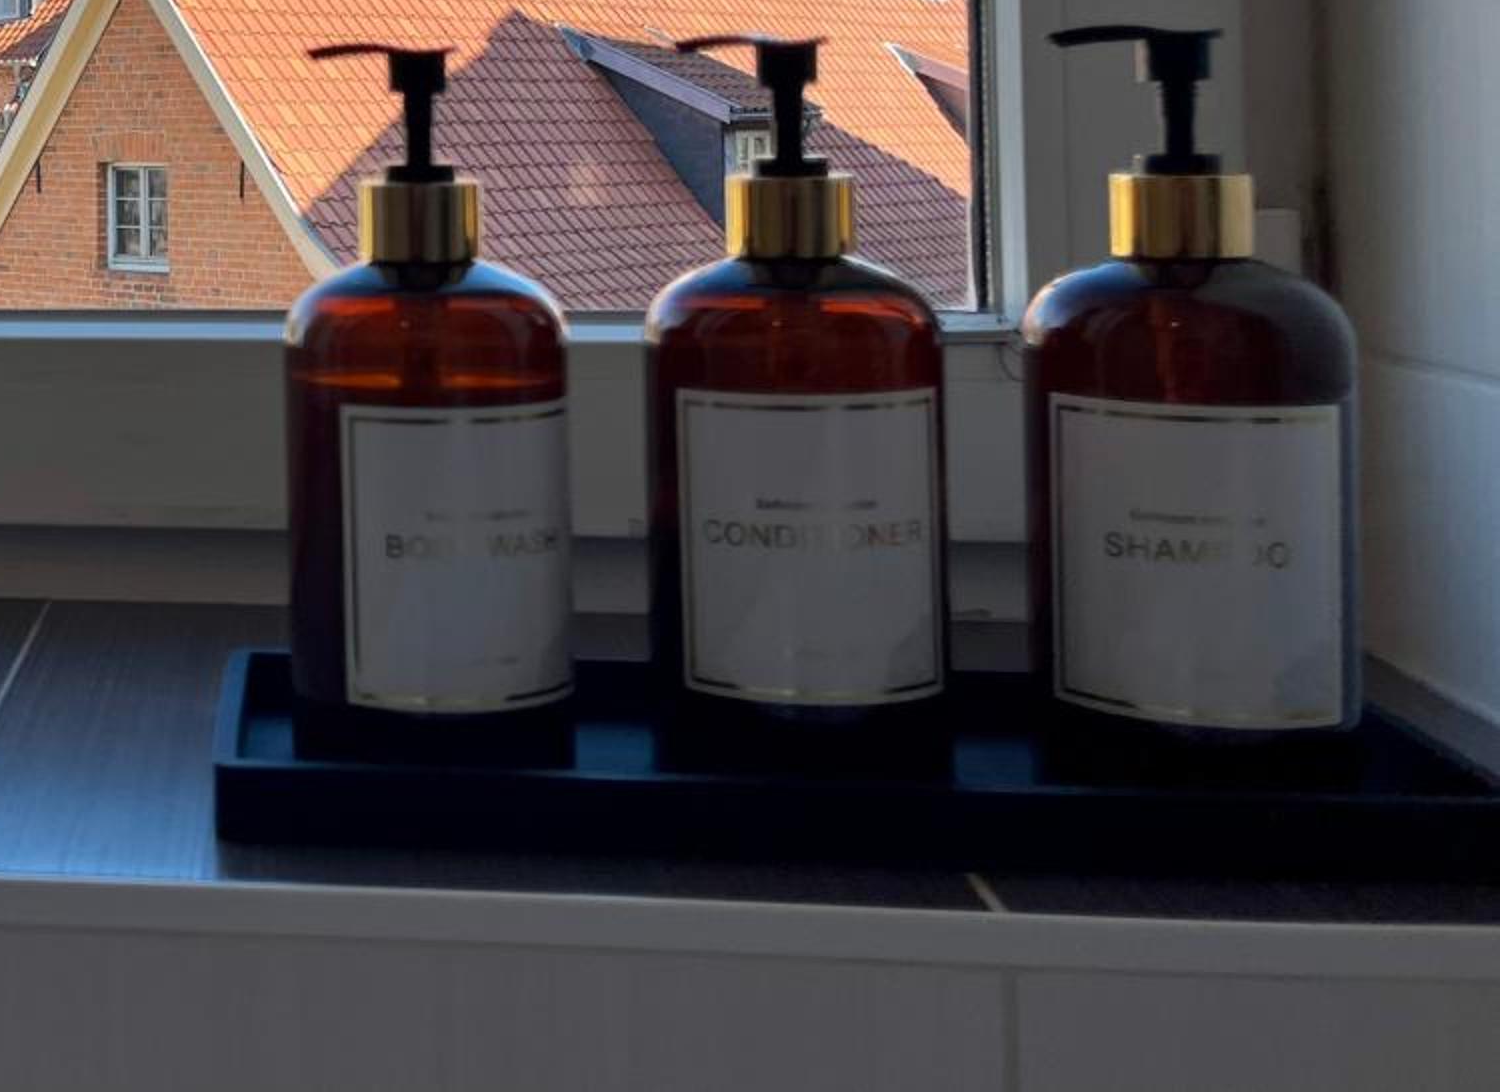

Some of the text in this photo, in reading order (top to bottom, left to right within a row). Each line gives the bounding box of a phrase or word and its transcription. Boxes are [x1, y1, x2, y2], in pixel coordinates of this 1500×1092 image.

[386, 534, 470, 560] BO
[702, 519, 924, 549] CONDIONER
[1104, 531, 1292, 570] SHAMO
